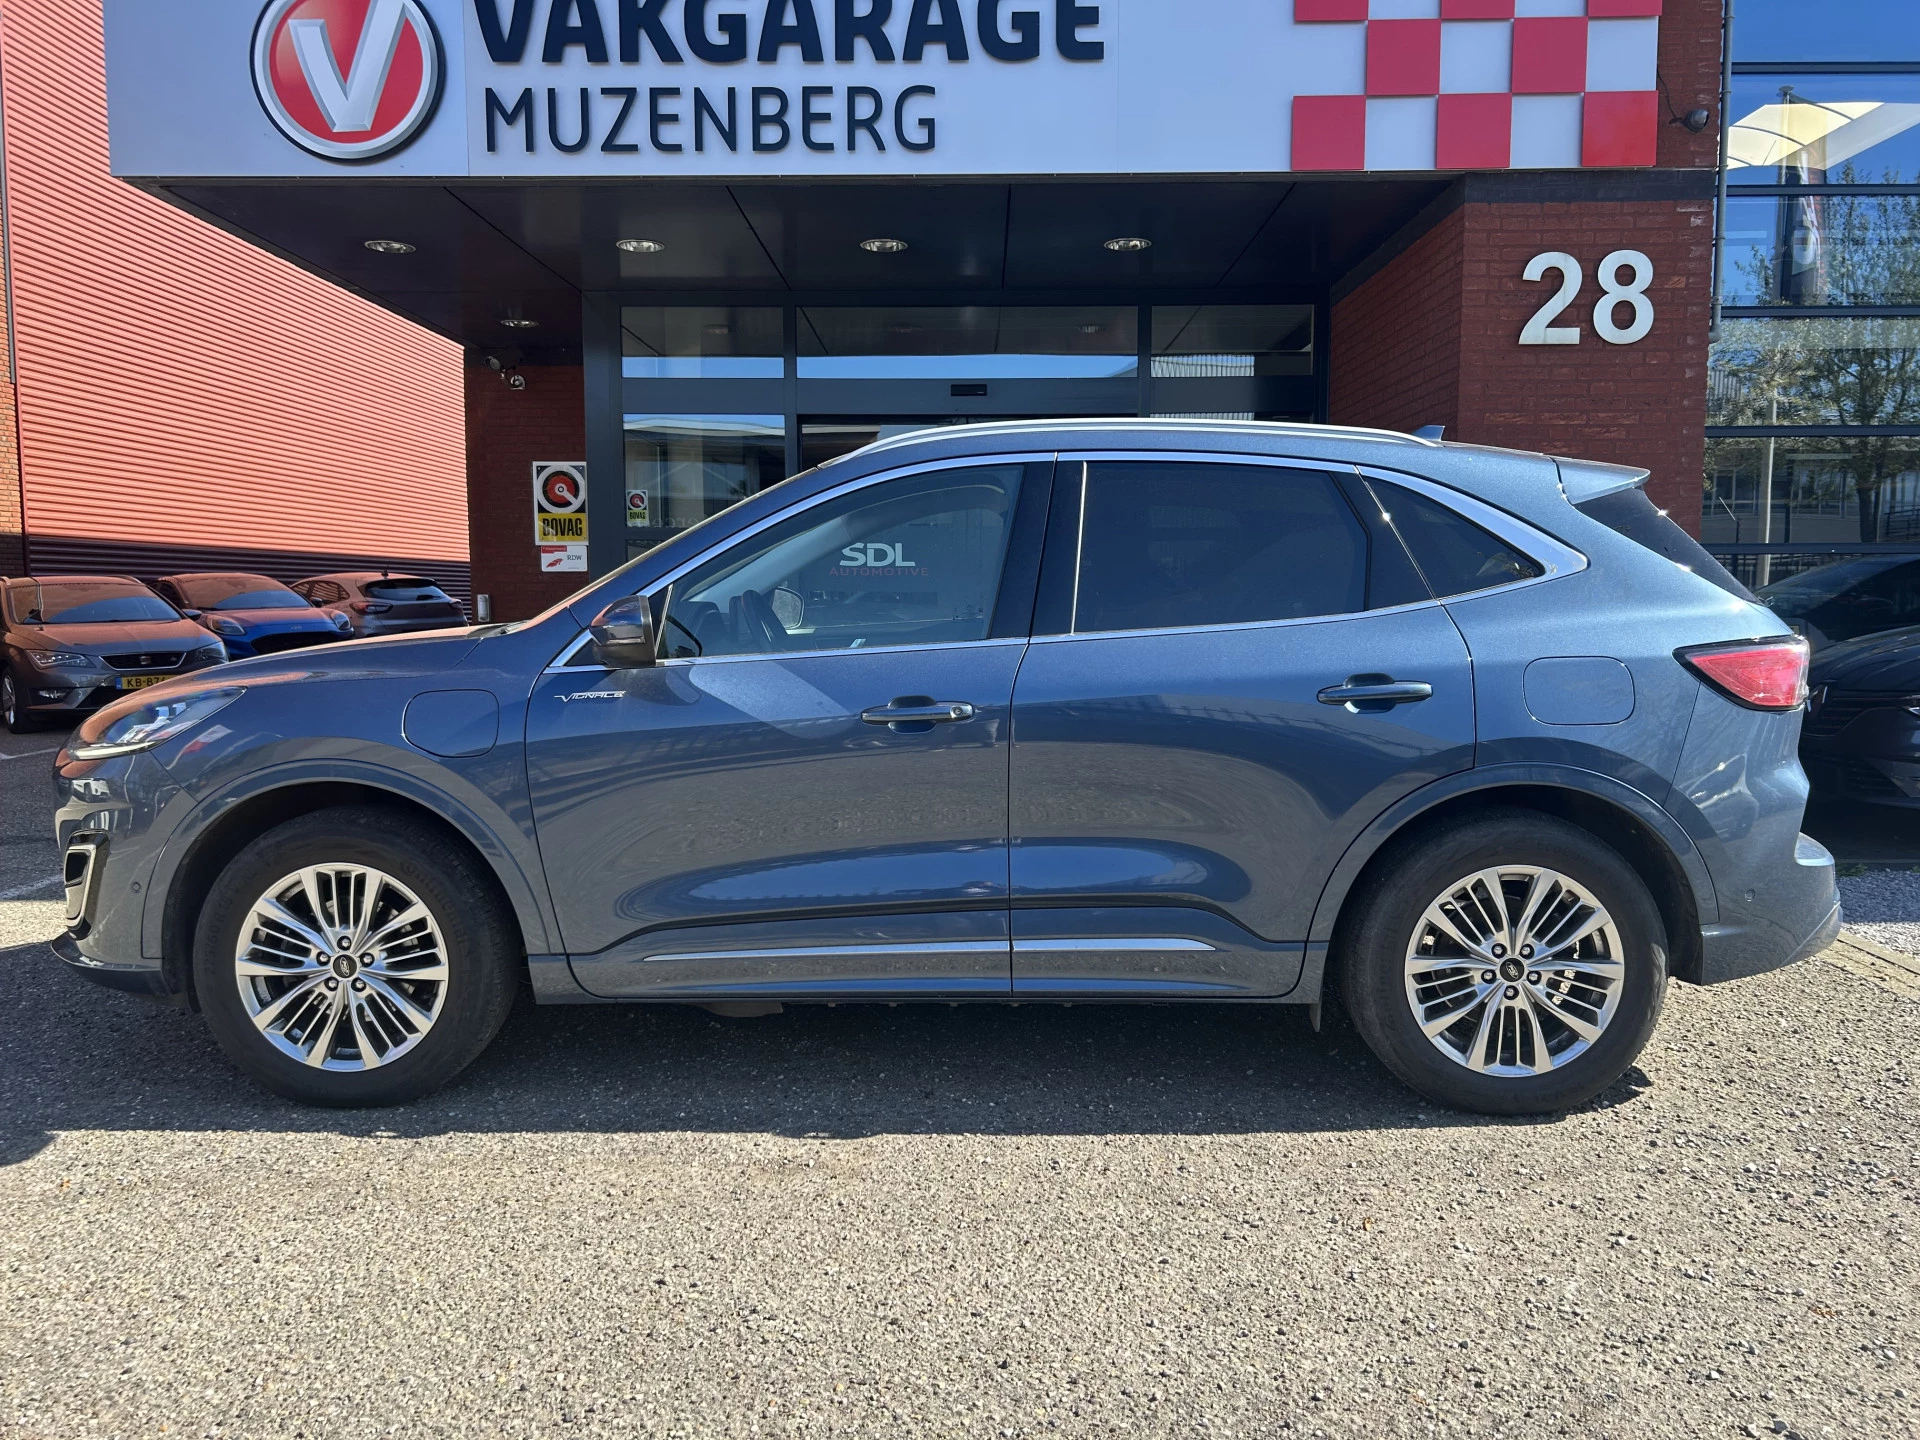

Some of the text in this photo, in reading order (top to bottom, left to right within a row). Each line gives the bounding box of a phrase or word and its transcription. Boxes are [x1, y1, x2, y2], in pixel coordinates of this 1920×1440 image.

[474, 0, 1105, 63] VAKGARAGE
[485, 85, 936, 153] MUZENBERG
[1518, 249, 1655, 345] 28
[542, 518, 583, 536] BOVAG
[629, 511, 646, 520] BOVAG
[840, 542, 916, 567] SDL
[829, 567, 929, 576] AUTOMOTIVE
